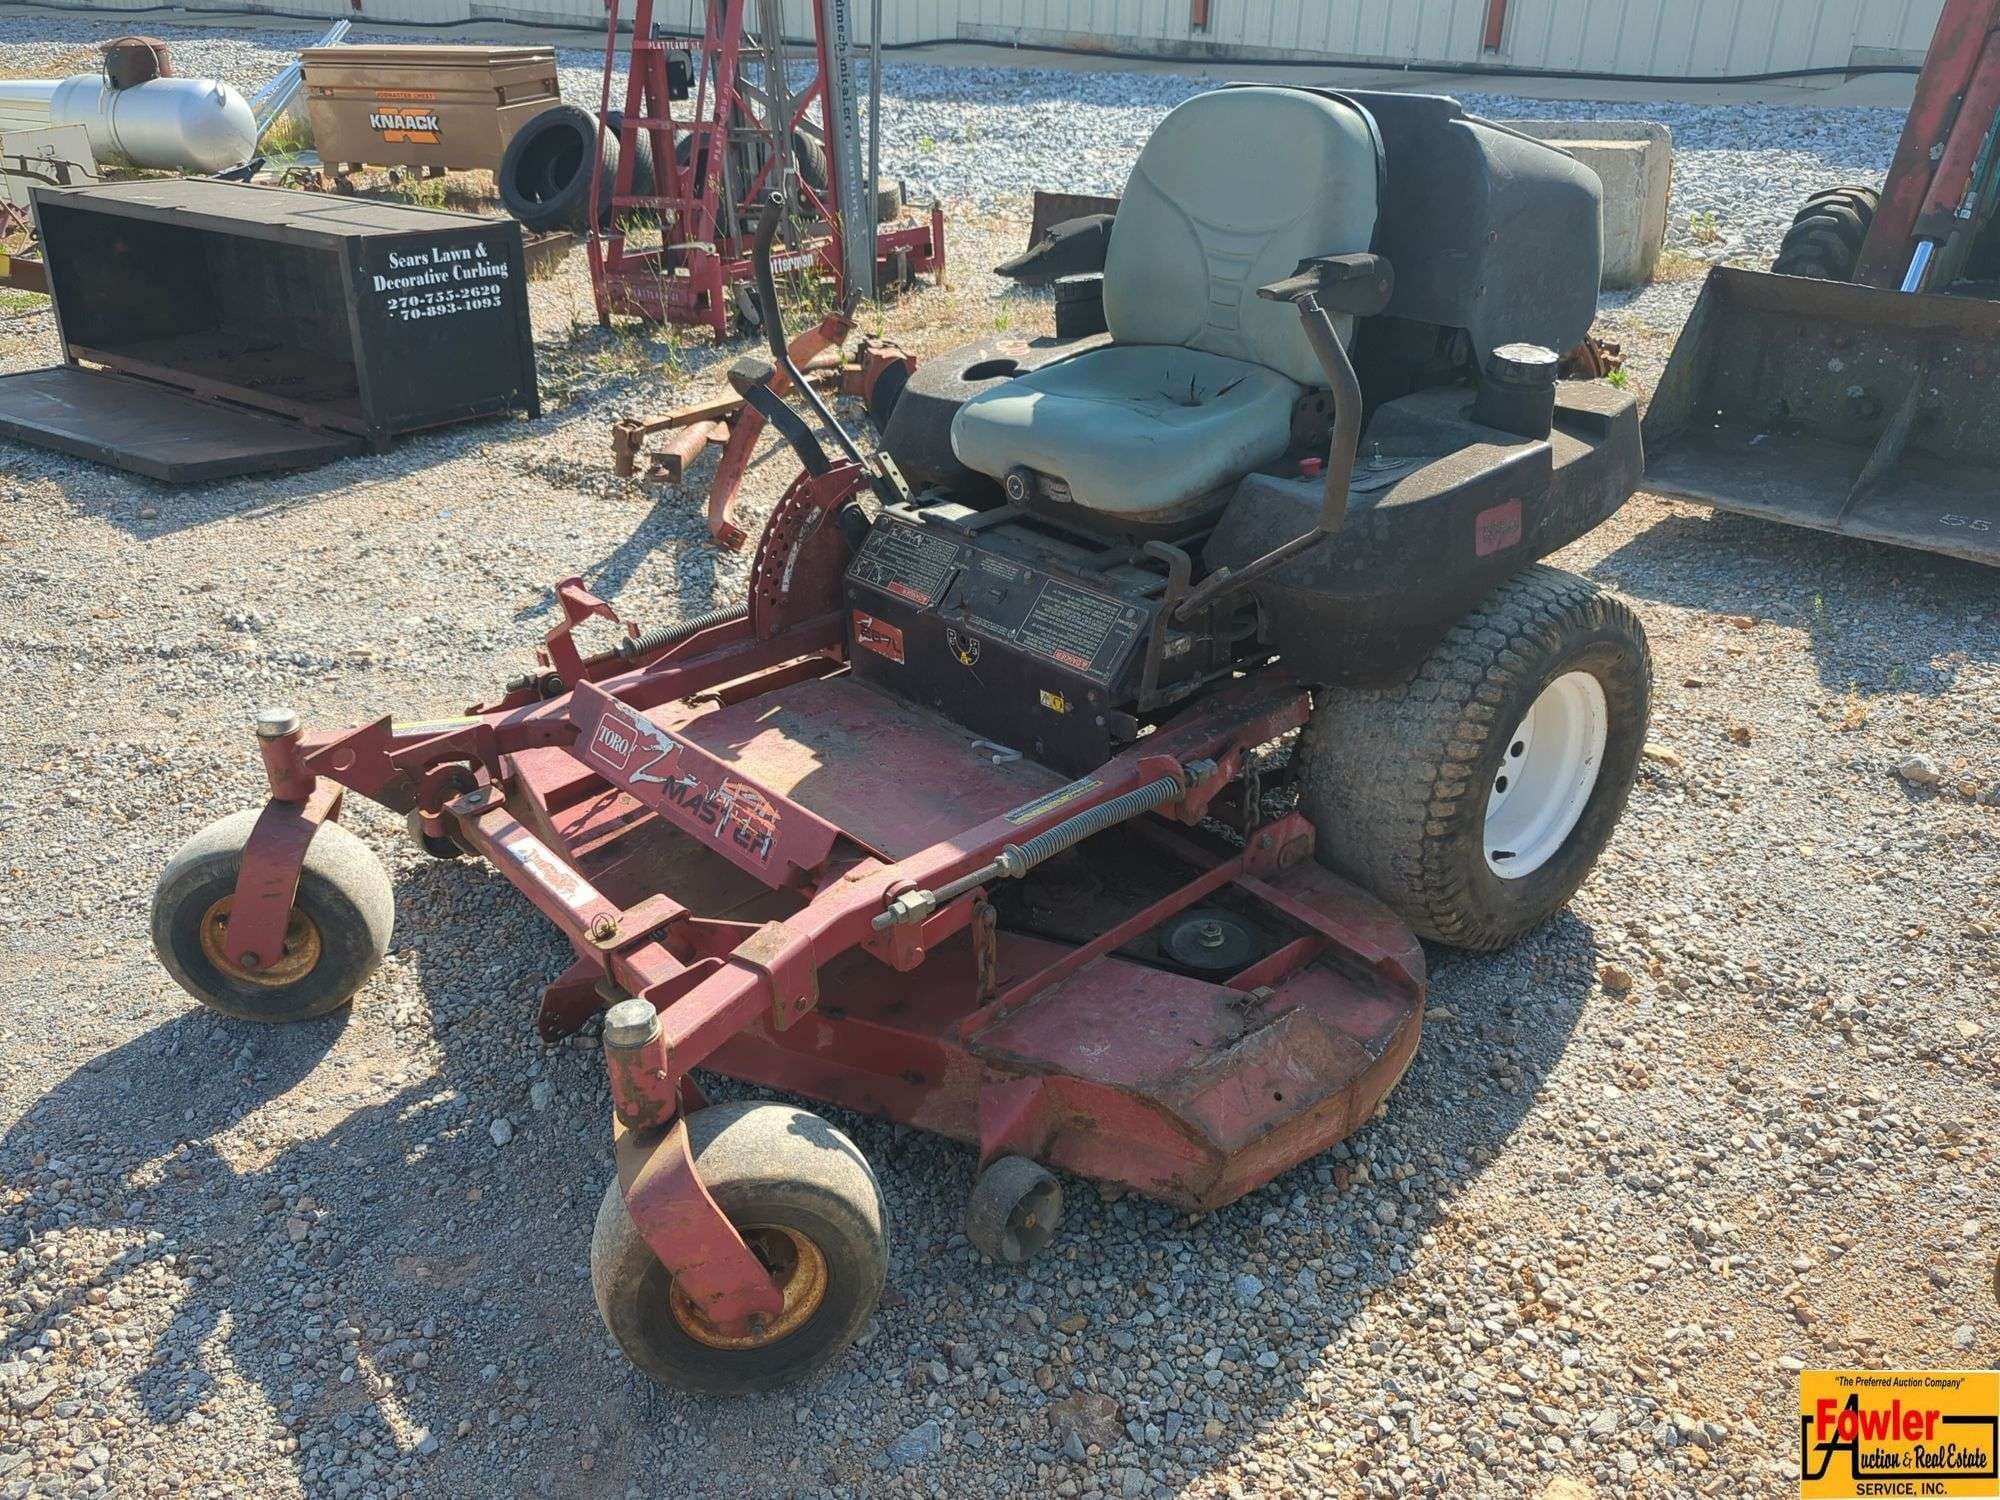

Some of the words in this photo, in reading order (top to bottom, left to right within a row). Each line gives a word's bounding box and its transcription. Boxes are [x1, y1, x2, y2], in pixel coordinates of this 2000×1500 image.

[369, 113, 440, 131] KNAACK
[388, 252, 430, 269] Sears
[431, 247, 472, 264] Lawn
[474, 241, 488, 258] &
[372, 268, 450, 292] Decorative
[452, 261, 509, 280] Curbing
[387, 284, 501, 310] 270-755-2620
[388, 296, 502, 320] 70-893-1095
[597, 724, 630, 755] TORO
